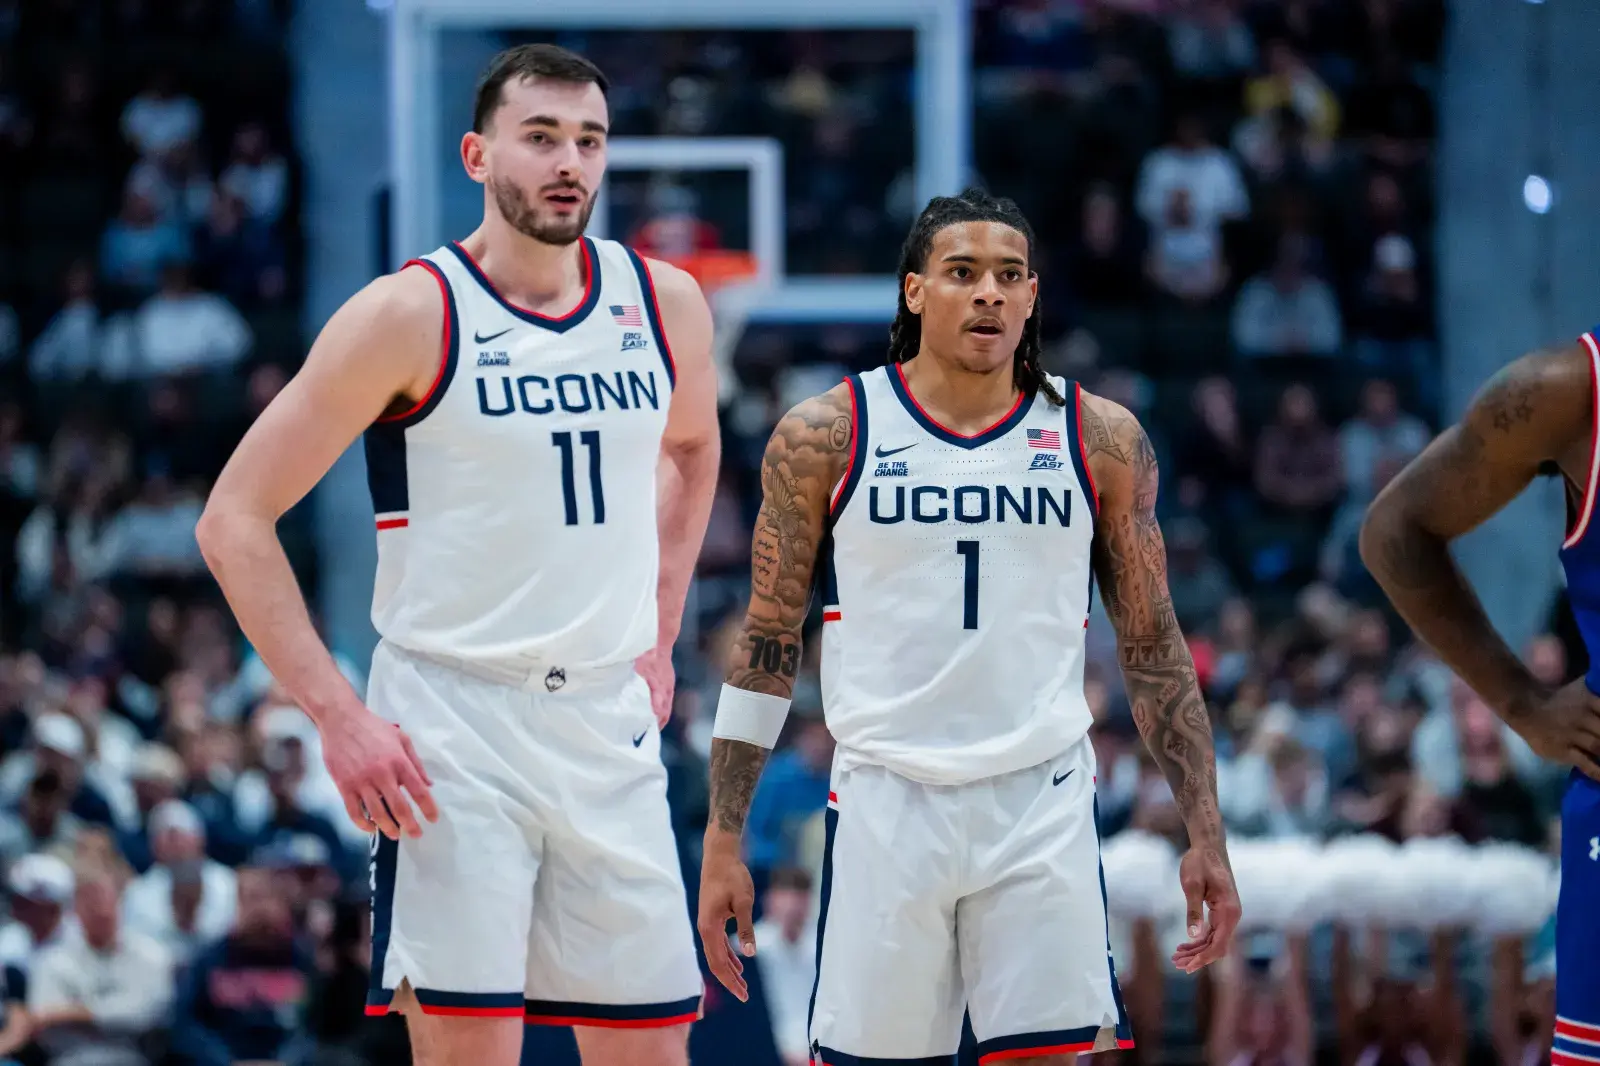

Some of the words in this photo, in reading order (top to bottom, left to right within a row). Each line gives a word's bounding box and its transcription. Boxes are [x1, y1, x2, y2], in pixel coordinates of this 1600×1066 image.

[624, 332, 642, 340] BIG
[622, 340, 648, 348] EAST
[477, 358, 511, 367] CHANGE
[476, 371, 659, 417] UCONN
[1034, 453, 1058, 461] BIG
[891, 461, 907, 469] THE
[1030, 461, 1065, 469] EAST
[874, 468, 909, 477] CHANGE
[551, 430, 605, 525] 11
[869, 485, 1072, 528] UCONN
[957, 541, 980, 630] 1
[748, 635, 799, 677] 703
